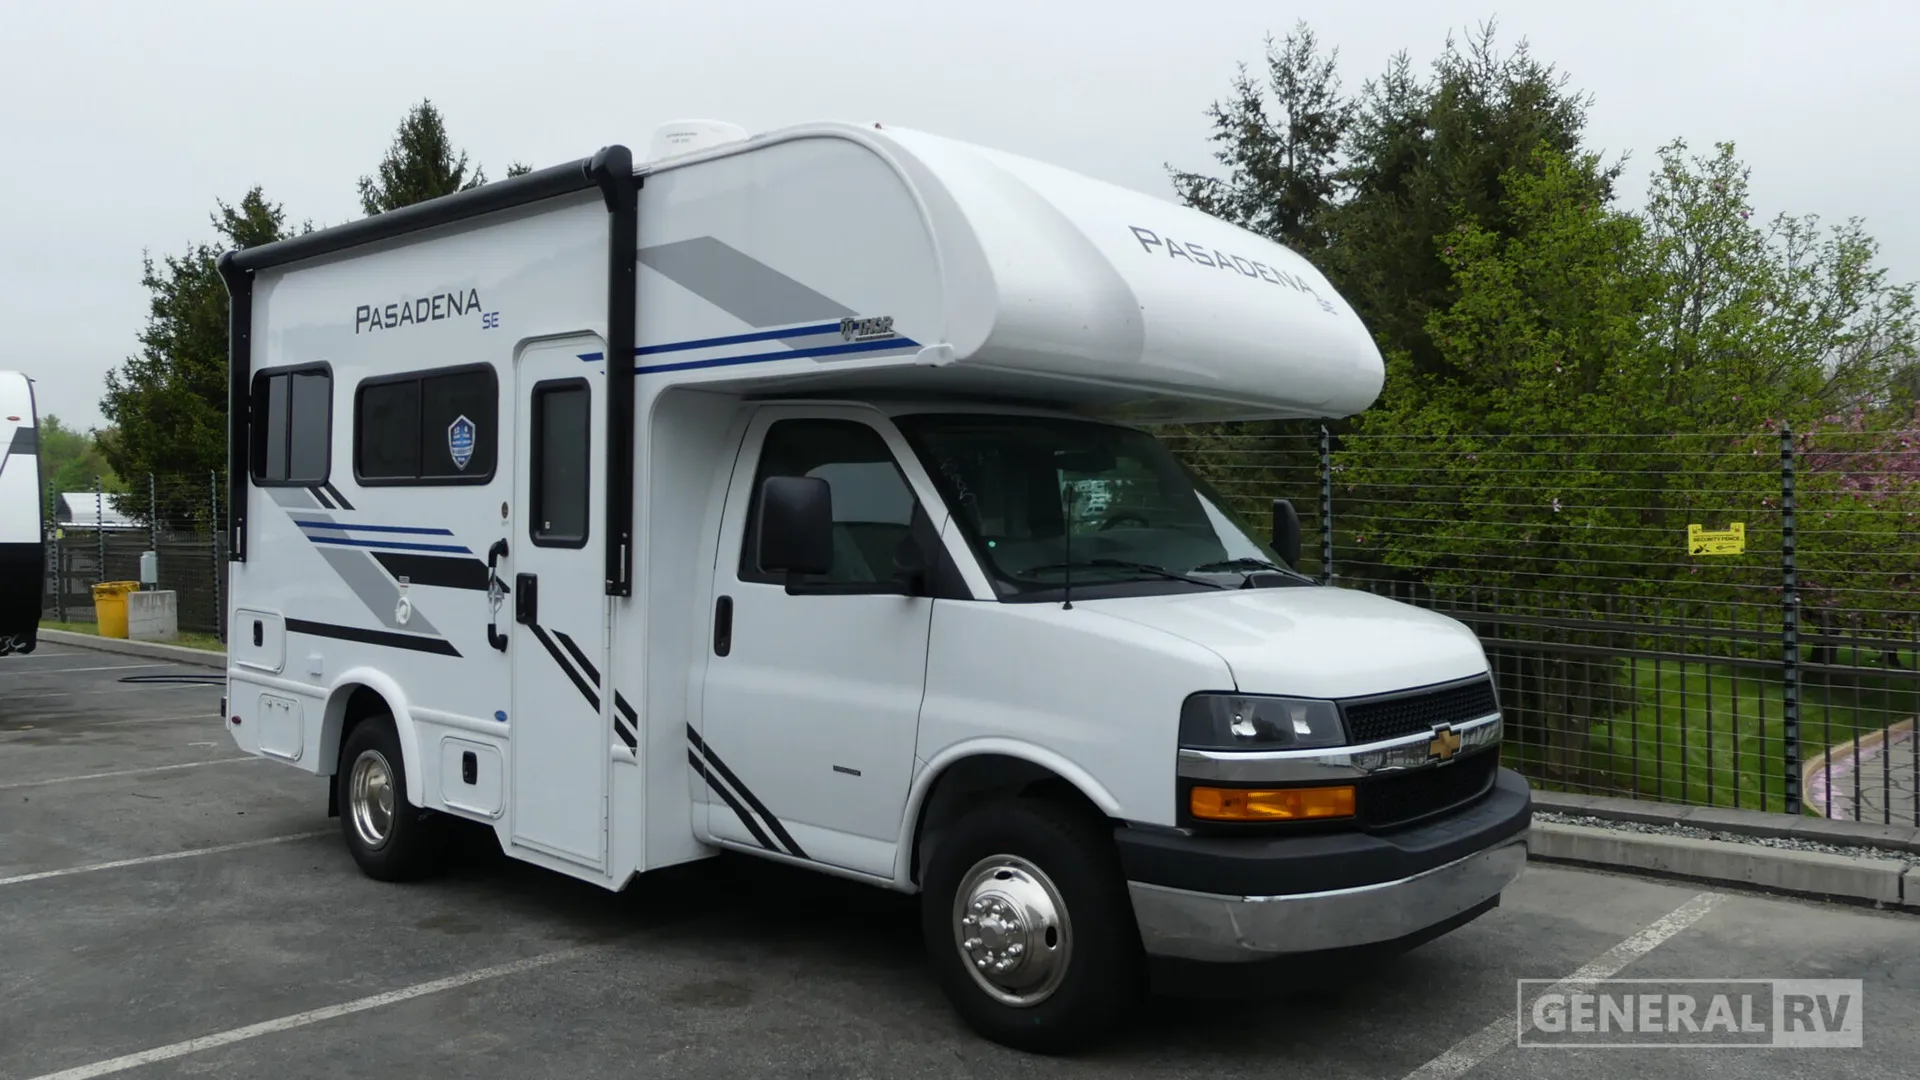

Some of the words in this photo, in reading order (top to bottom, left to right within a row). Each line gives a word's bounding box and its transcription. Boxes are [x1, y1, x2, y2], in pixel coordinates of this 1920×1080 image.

[1128, 225, 1320, 298] PASADENA
[355, 288, 482, 334] PASADENA
[482, 311, 499, 329] SE
